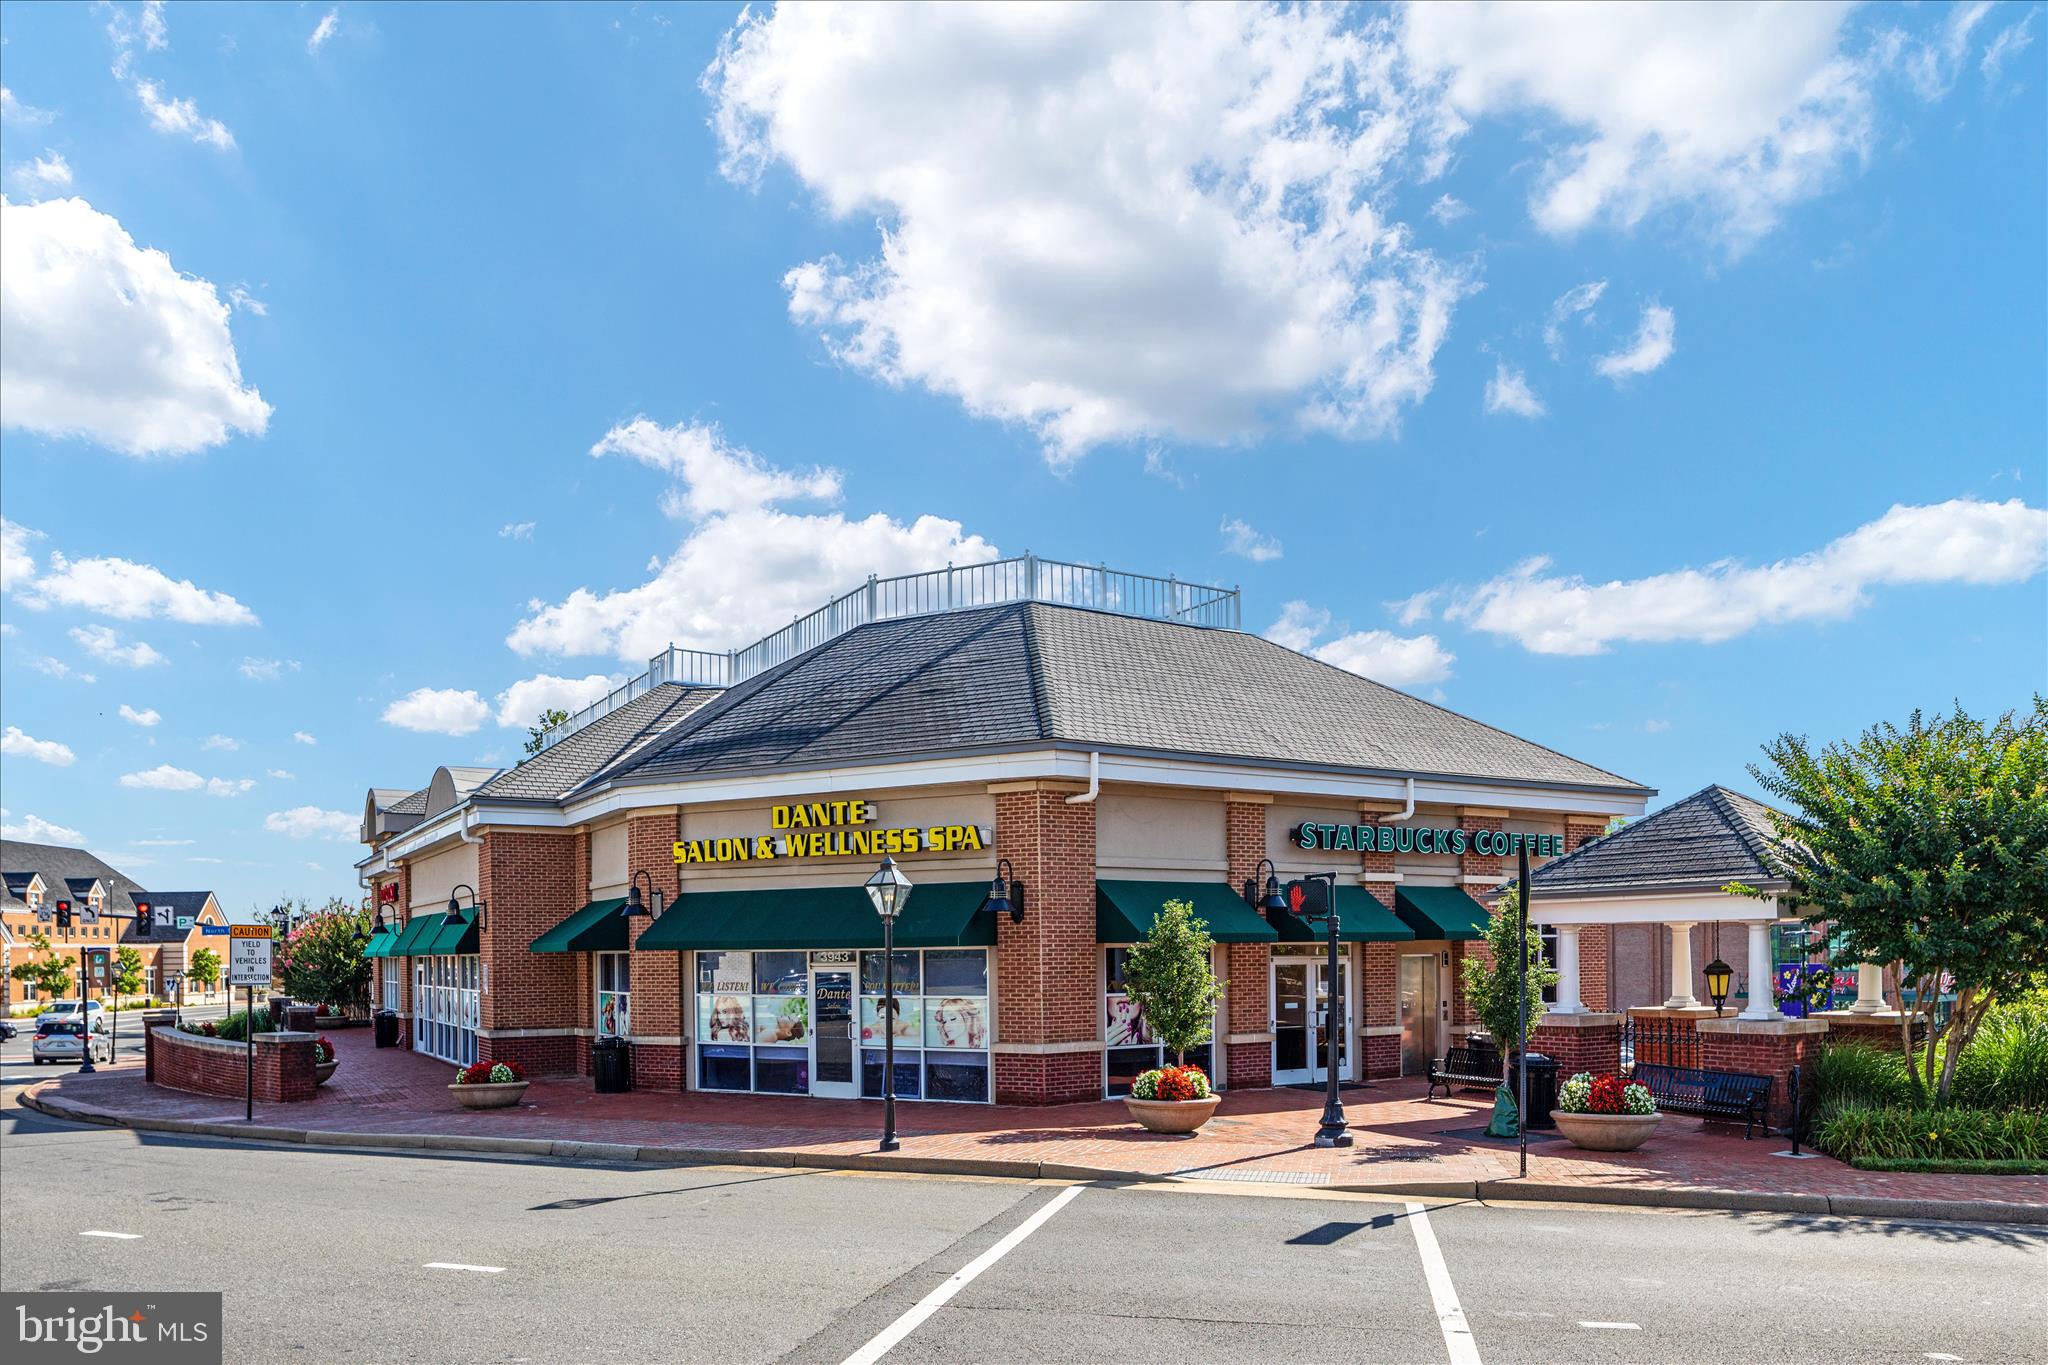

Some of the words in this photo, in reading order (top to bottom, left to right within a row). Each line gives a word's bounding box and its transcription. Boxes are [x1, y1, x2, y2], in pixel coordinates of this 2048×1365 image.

[771, 800, 867, 829] DANTE
[673, 837, 749, 864] SALON
[756, 835, 775, 860] &
[784, 827, 920, 858] WELLNESS
[927, 825, 983, 852] SPA
[1299, 821, 1466, 855] STARBUCKS
[1474, 829, 1565, 857] COFFEE
[233, 927, 269, 936] CAUTION
[242, 940, 261, 948] YIELD
[235, 957, 267, 965] VEHICLES
[820, 951, 849, 962] 3943
[717, 982, 749, 992] LISTEN!
[816, 988, 851, 1000] Dante
